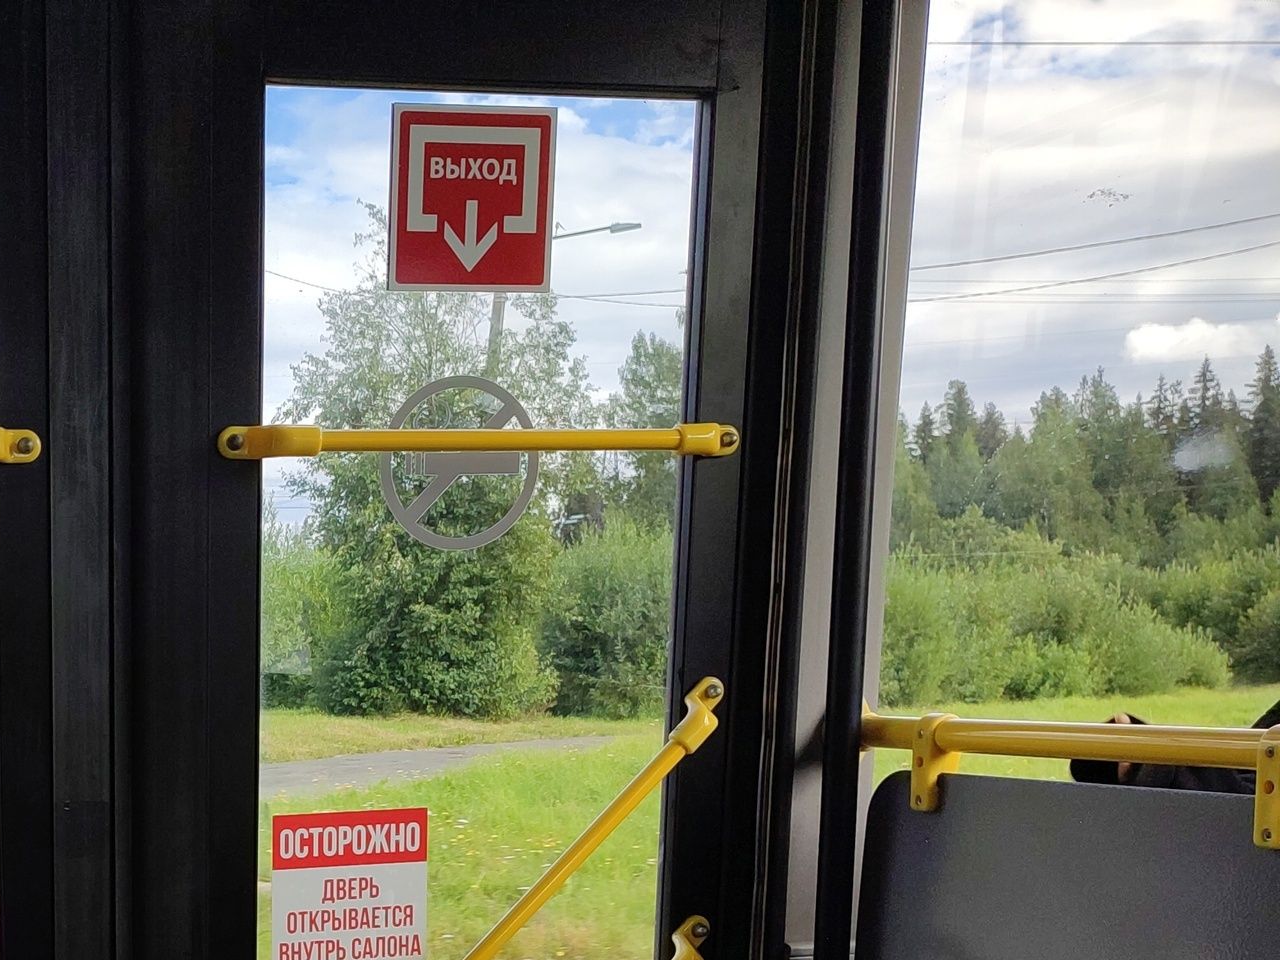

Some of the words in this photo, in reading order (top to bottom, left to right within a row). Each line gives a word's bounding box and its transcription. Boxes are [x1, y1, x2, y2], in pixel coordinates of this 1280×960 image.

[429, 156, 517, 186] ВЫХОД
[279, 822, 420, 859] ОСТОРОЖНО
[322, 877, 380, 904] ДВЕРЬ
[287, 904, 414, 934] ОТКРЫВАЕТСЯ
[351, 934, 422, 960] САЛОНА
